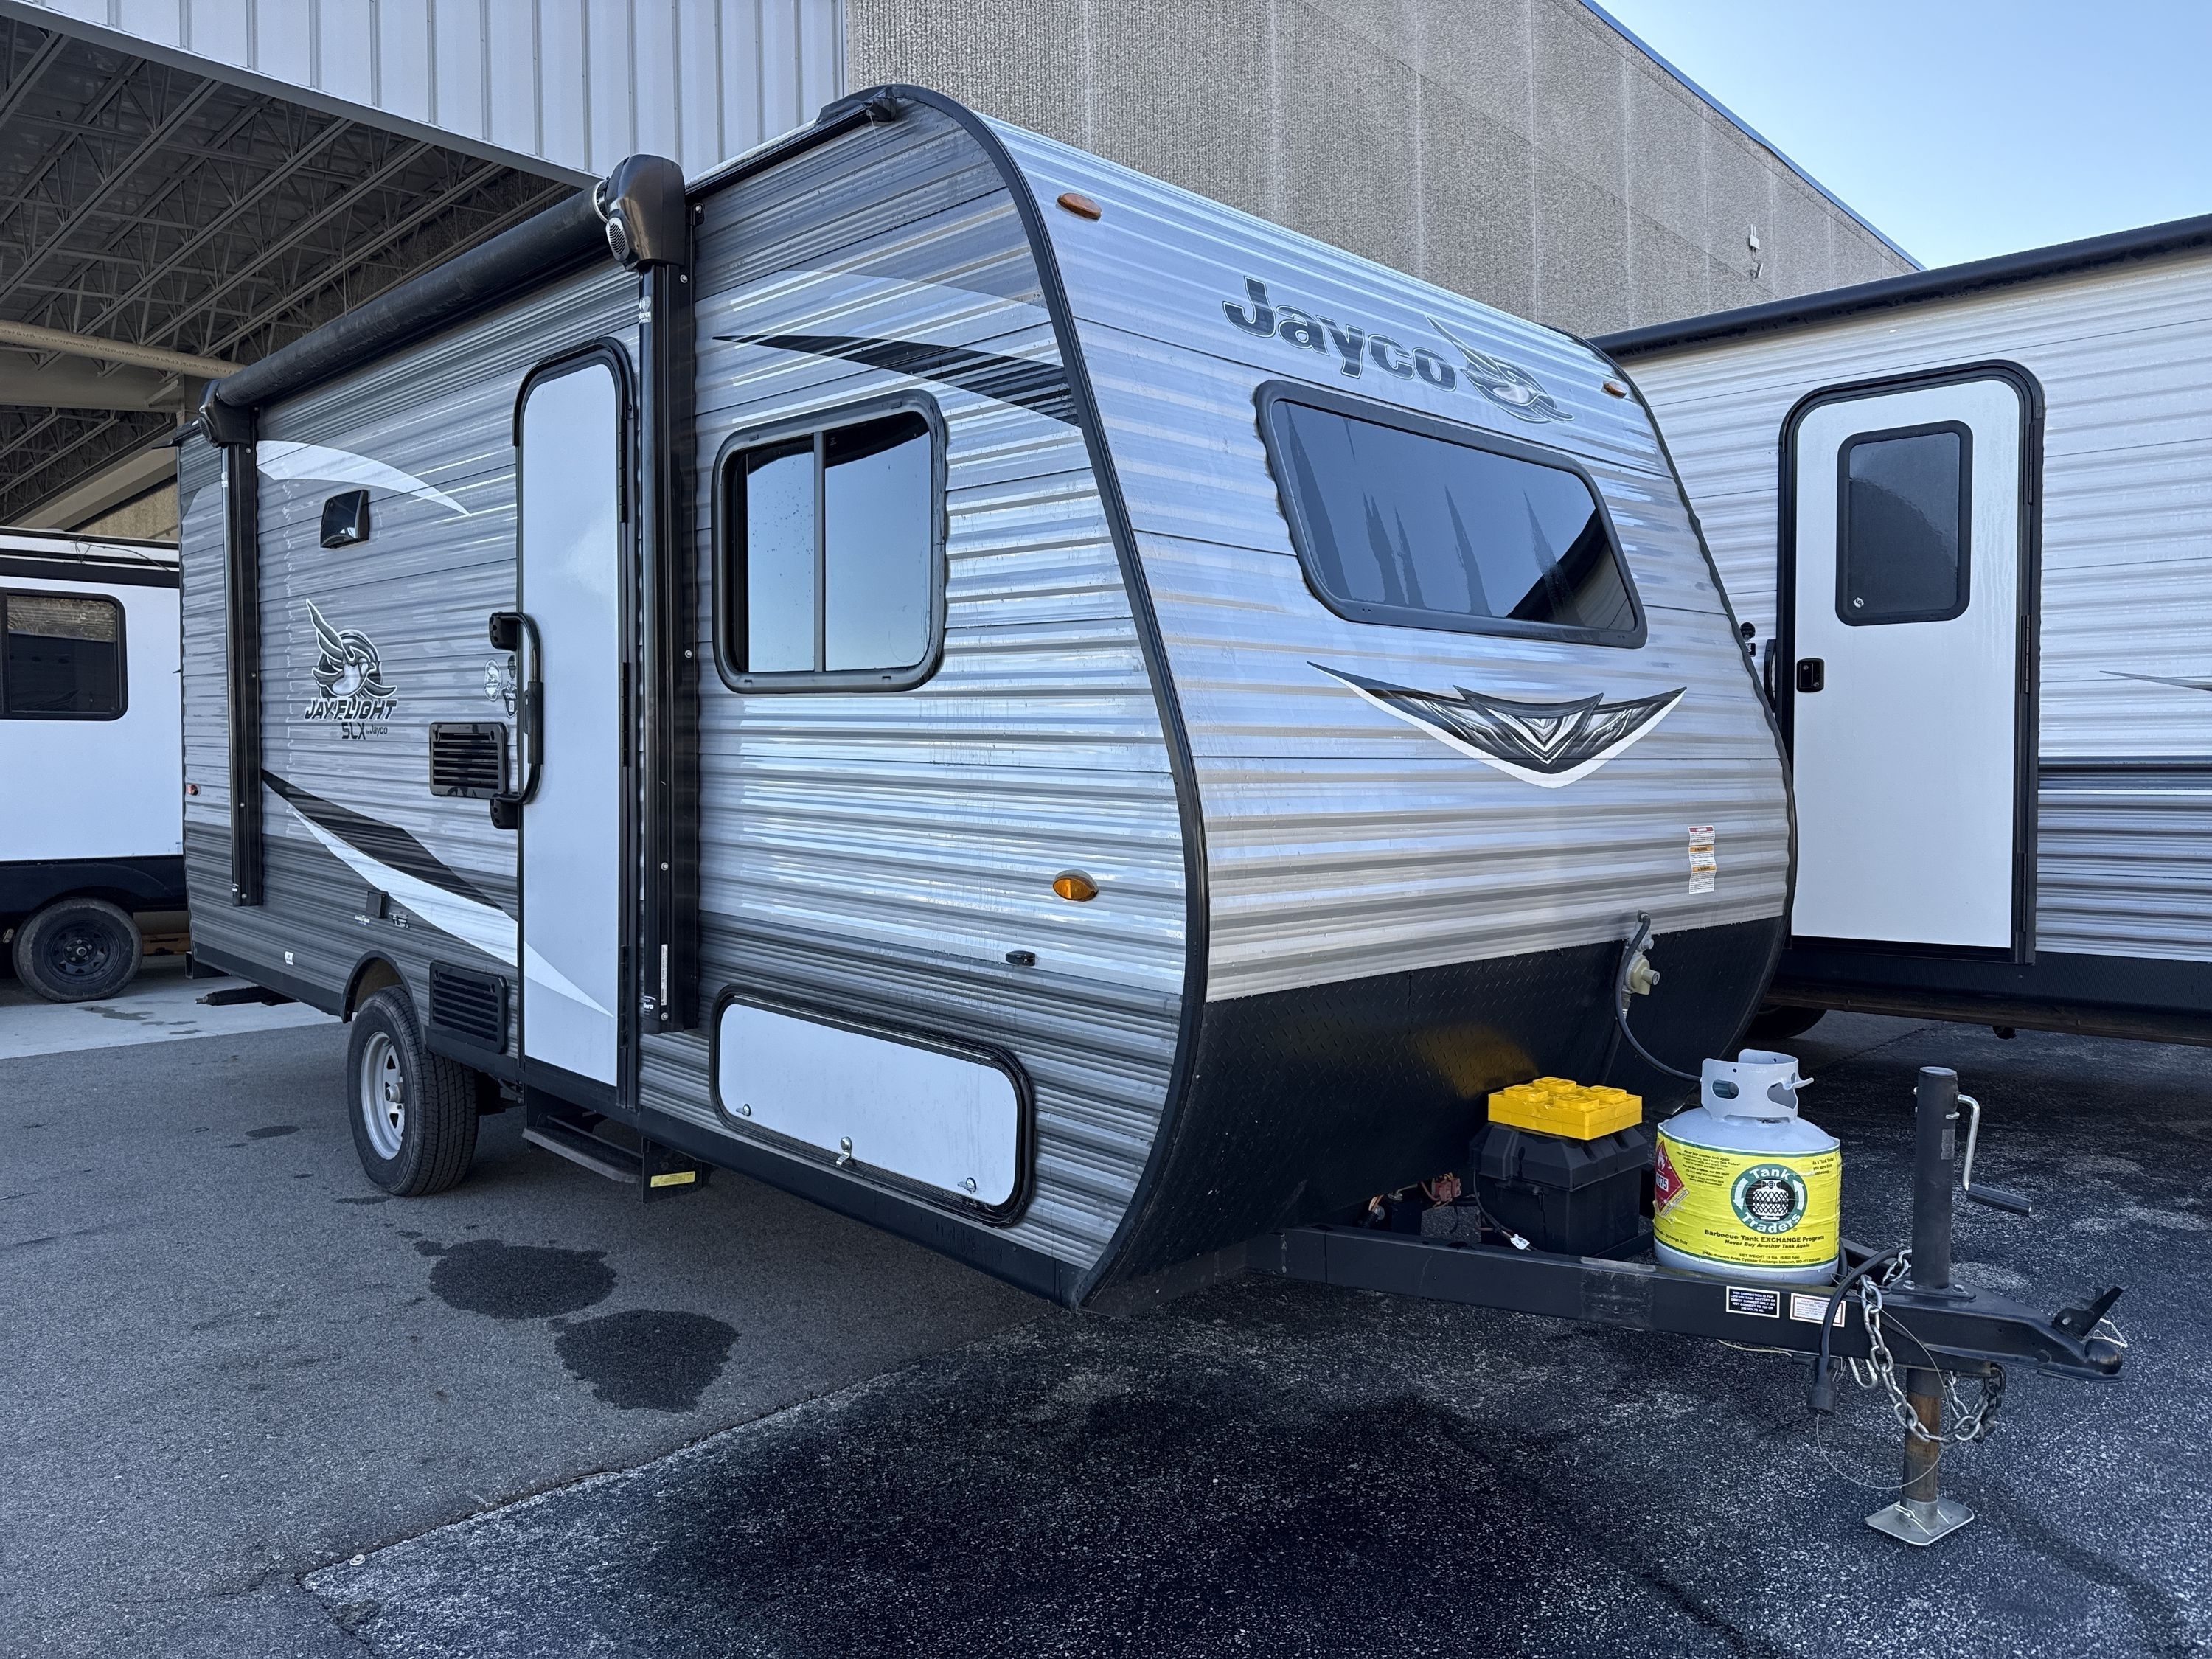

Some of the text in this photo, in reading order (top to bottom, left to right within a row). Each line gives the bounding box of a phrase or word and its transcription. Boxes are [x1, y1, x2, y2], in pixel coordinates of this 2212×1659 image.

[1222, 276, 1458, 392] Jayco
[304, 698, 398, 720] JAY FLIGHT
[341, 722, 366, 740] SLX
[369, 724, 388, 737] Jayco
[1749, 1168, 1790, 1180] Tank
[1742, 1211, 1801, 1233] Traders
[1705, 1229, 1739, 1239] Barbecue
